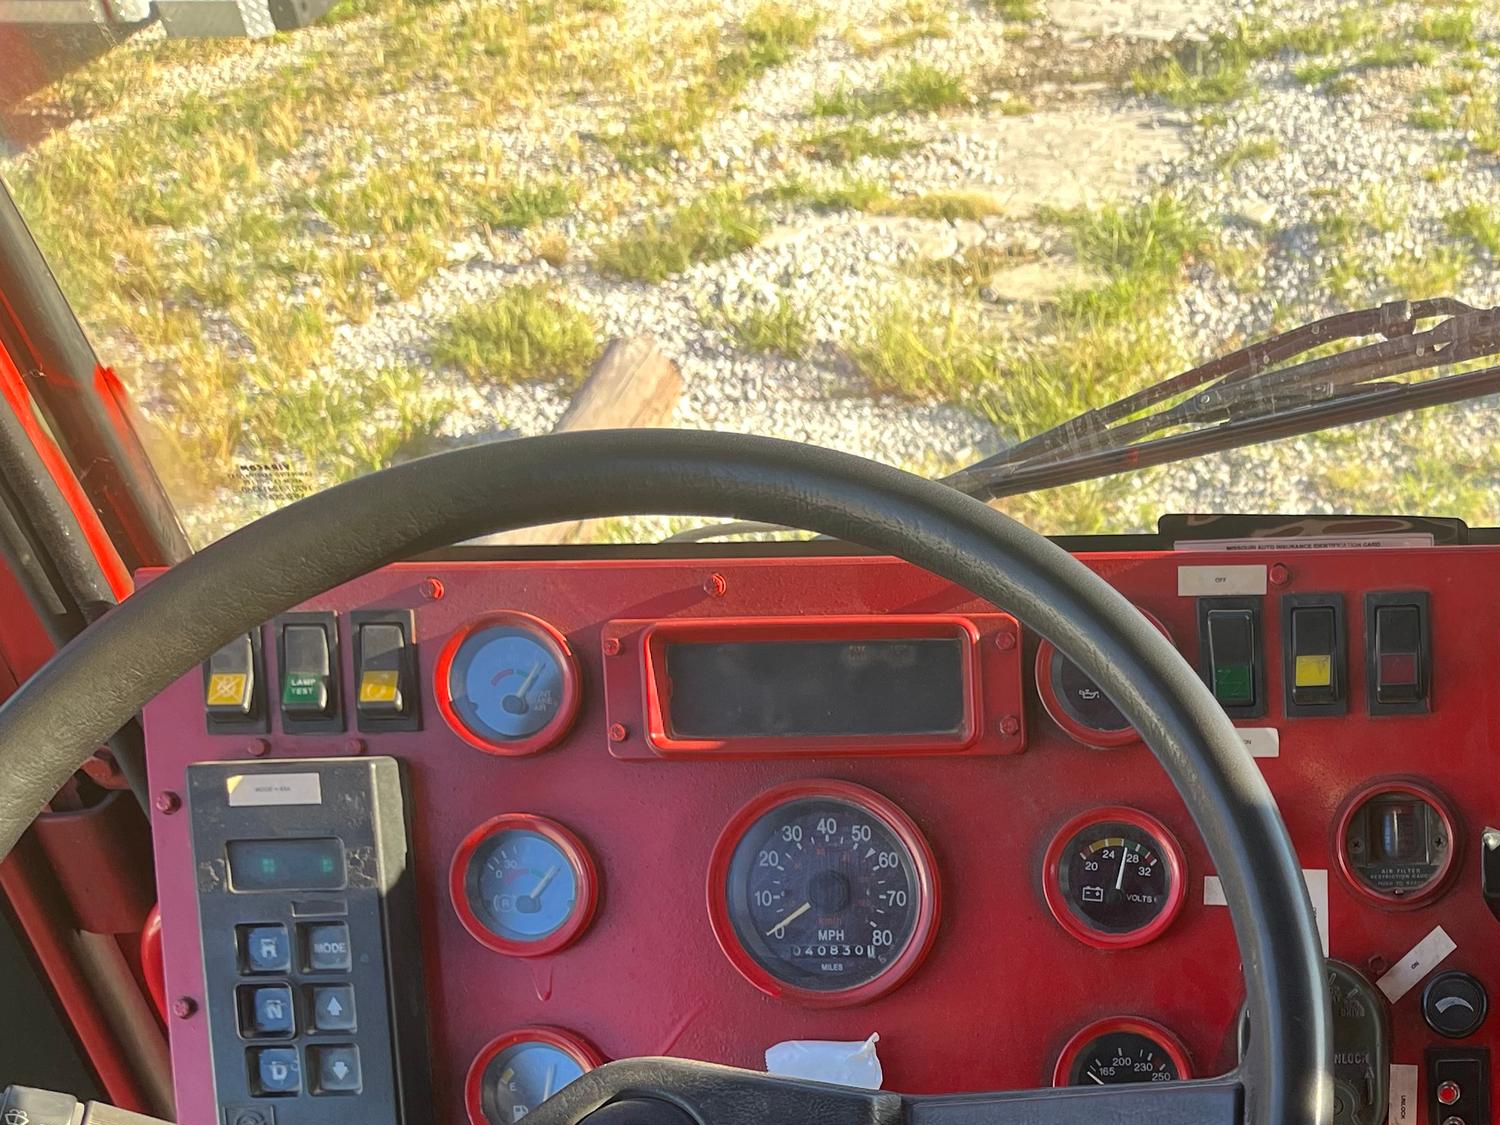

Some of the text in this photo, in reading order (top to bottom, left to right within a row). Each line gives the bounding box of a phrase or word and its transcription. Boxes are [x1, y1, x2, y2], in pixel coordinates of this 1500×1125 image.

[291, 679, 316, 687] LAMP
[291, 687, 313, 696] TEST
[817, 818, 837, 834] 40
[782, 825, 802, 842] 30
[852, 825, 871, 841] 50
[759, 850, 779, 867] 20
[1102, 849, 1115, 859] 24
[1126, 854, 1139, 863] 28
[503, 860, 518, 869] 30
[878, 852, 898, 868] 60
[1085, 862, 1098, 871] 20
[1138, 867, 1151, 876] 32
[755, 890, 772, 906] 10
[887, 891, 907, 907] 70
[1126, 894, 1152, 903] VOLTS
[818, 930, 845, 942] MPH
[872, 930, 893, 946] 80
[314, 943, 346, 954] MODE
[821, 963, 844, 971] MILES
[1112, 1057, 1132, 1066] 200
[1334, 1053, 1369, 1065] NLOCK
[1100, 1067, 1115, 1076] 165
[1134, 1063, 1153, 1072] 230
[1152, 1072, 1171, 1081] 250
[509, 1082, 517, 1091] E
